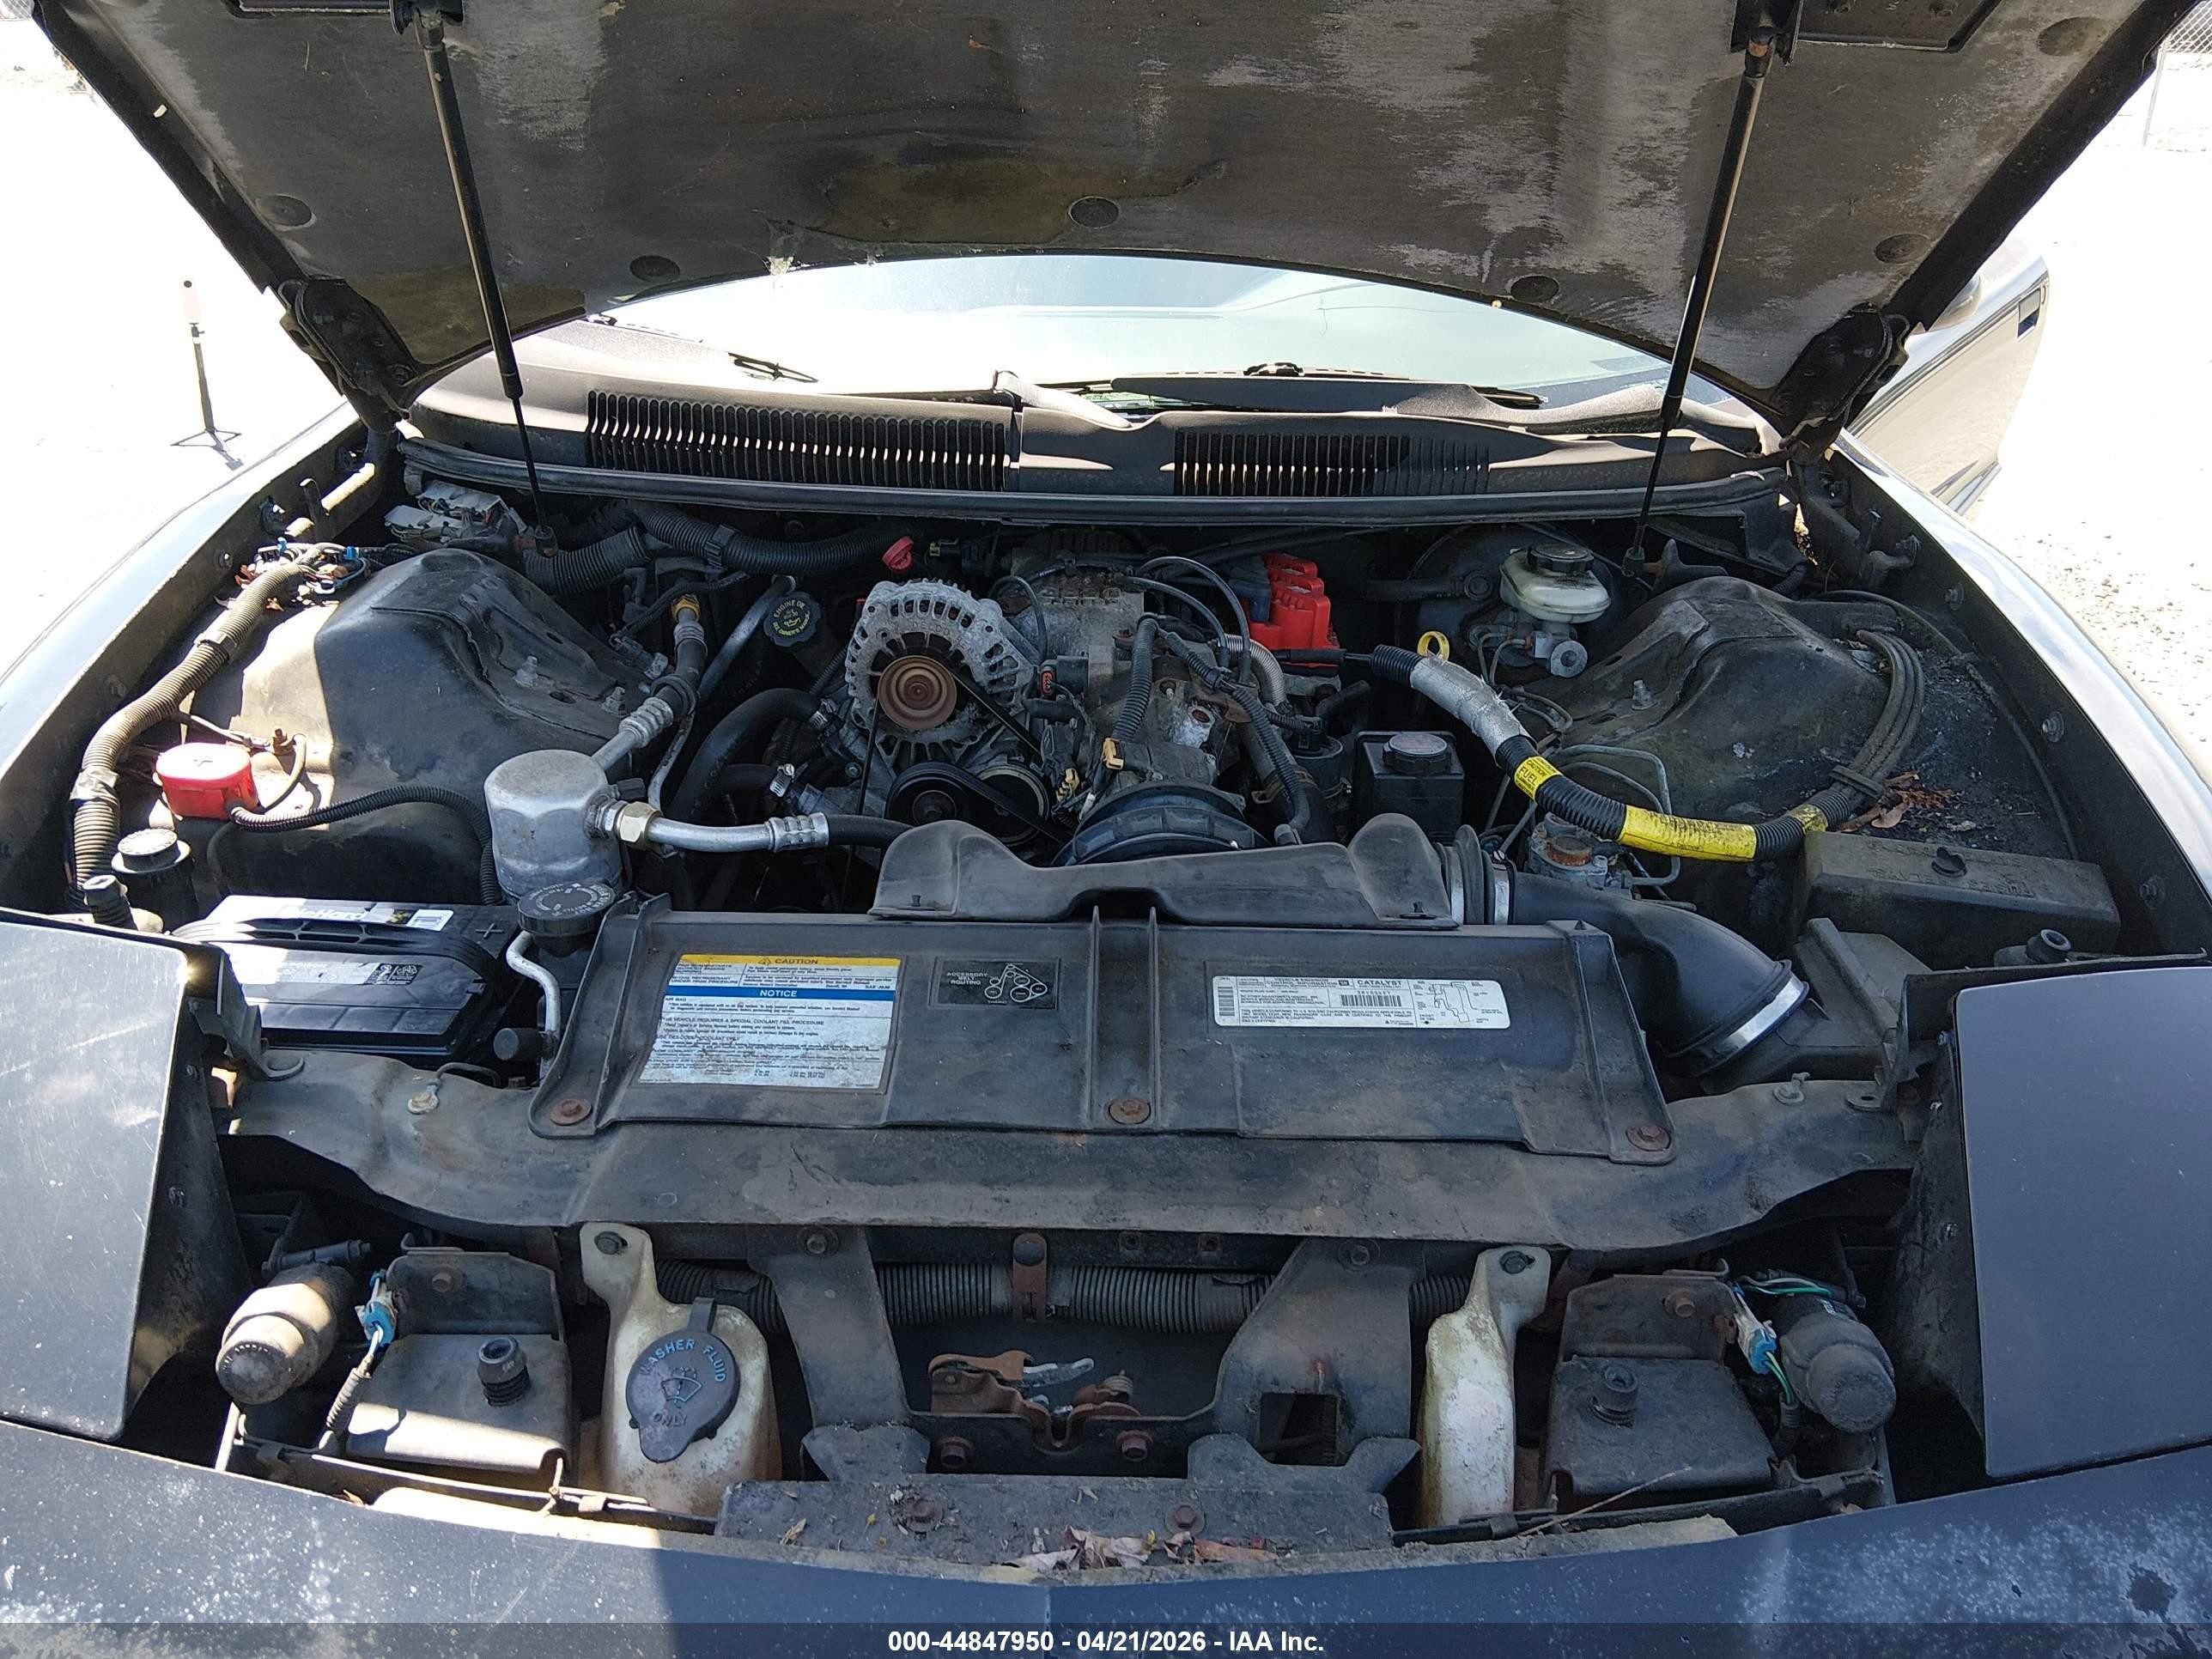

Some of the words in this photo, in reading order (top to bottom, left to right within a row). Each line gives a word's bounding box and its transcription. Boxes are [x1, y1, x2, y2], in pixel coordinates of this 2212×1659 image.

[1519, 766, 1537, 786] FUEL
[759, 989, 798, 998] NOTICE
[639, 1338, 696, 1376] WASHER
[702, 1345, 728, 1382] FLUID
[653, 1412, 687, 1427] ONLY
